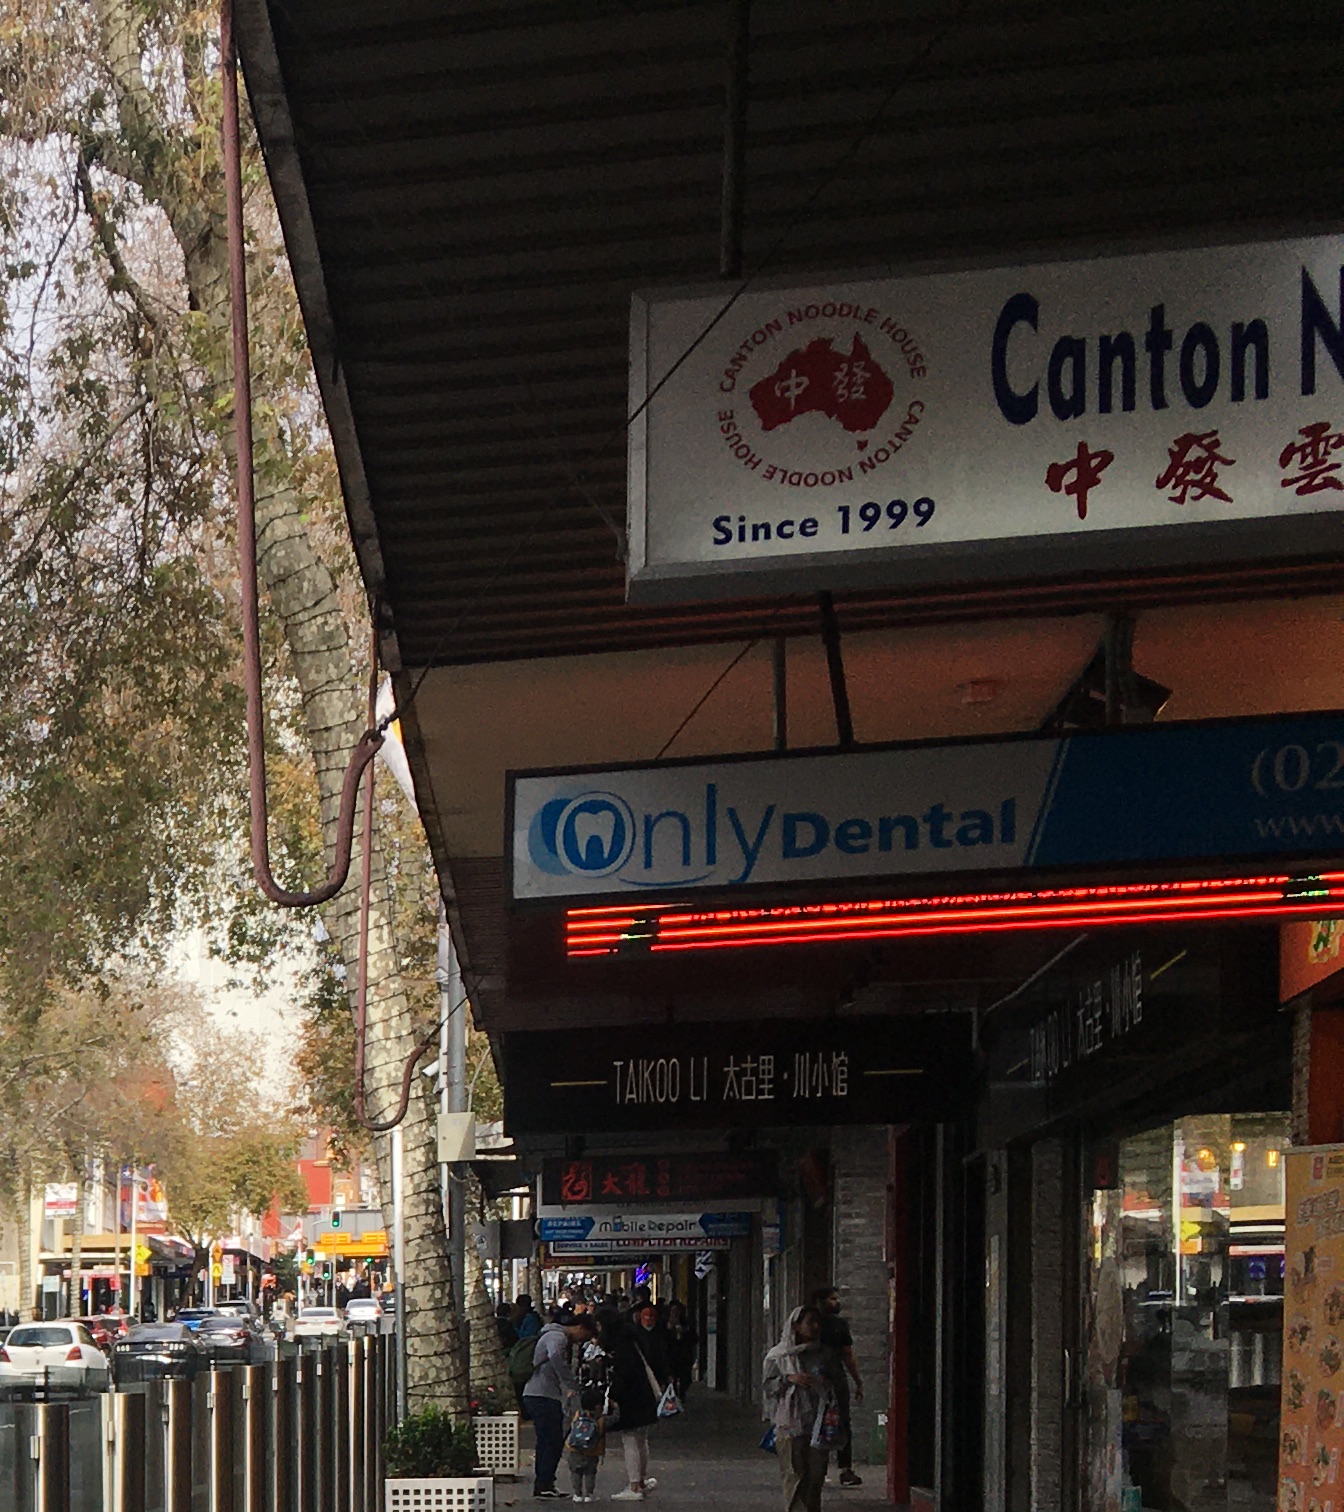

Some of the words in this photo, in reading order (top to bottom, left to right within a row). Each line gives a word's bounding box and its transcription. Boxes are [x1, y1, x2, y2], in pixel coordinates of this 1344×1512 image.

[720, 319, 782, 393] CANTON
[787, 302, 880, 326] NOODLE
[879, 317, 927, 380] HOUSE
[991, 292, 1270, 426] Canton
[718, 409, 763, 471] HOUSE
[859, 400, 925, 474] CANTON
[762, 464, 854, 488] NOODLE
[712, 515, 819, 546] Since
[837, 496, 936, 535] 1999
[613, 1057, 680, 1105] TAIKOO
[689, 1056, 709, 1101] LI
